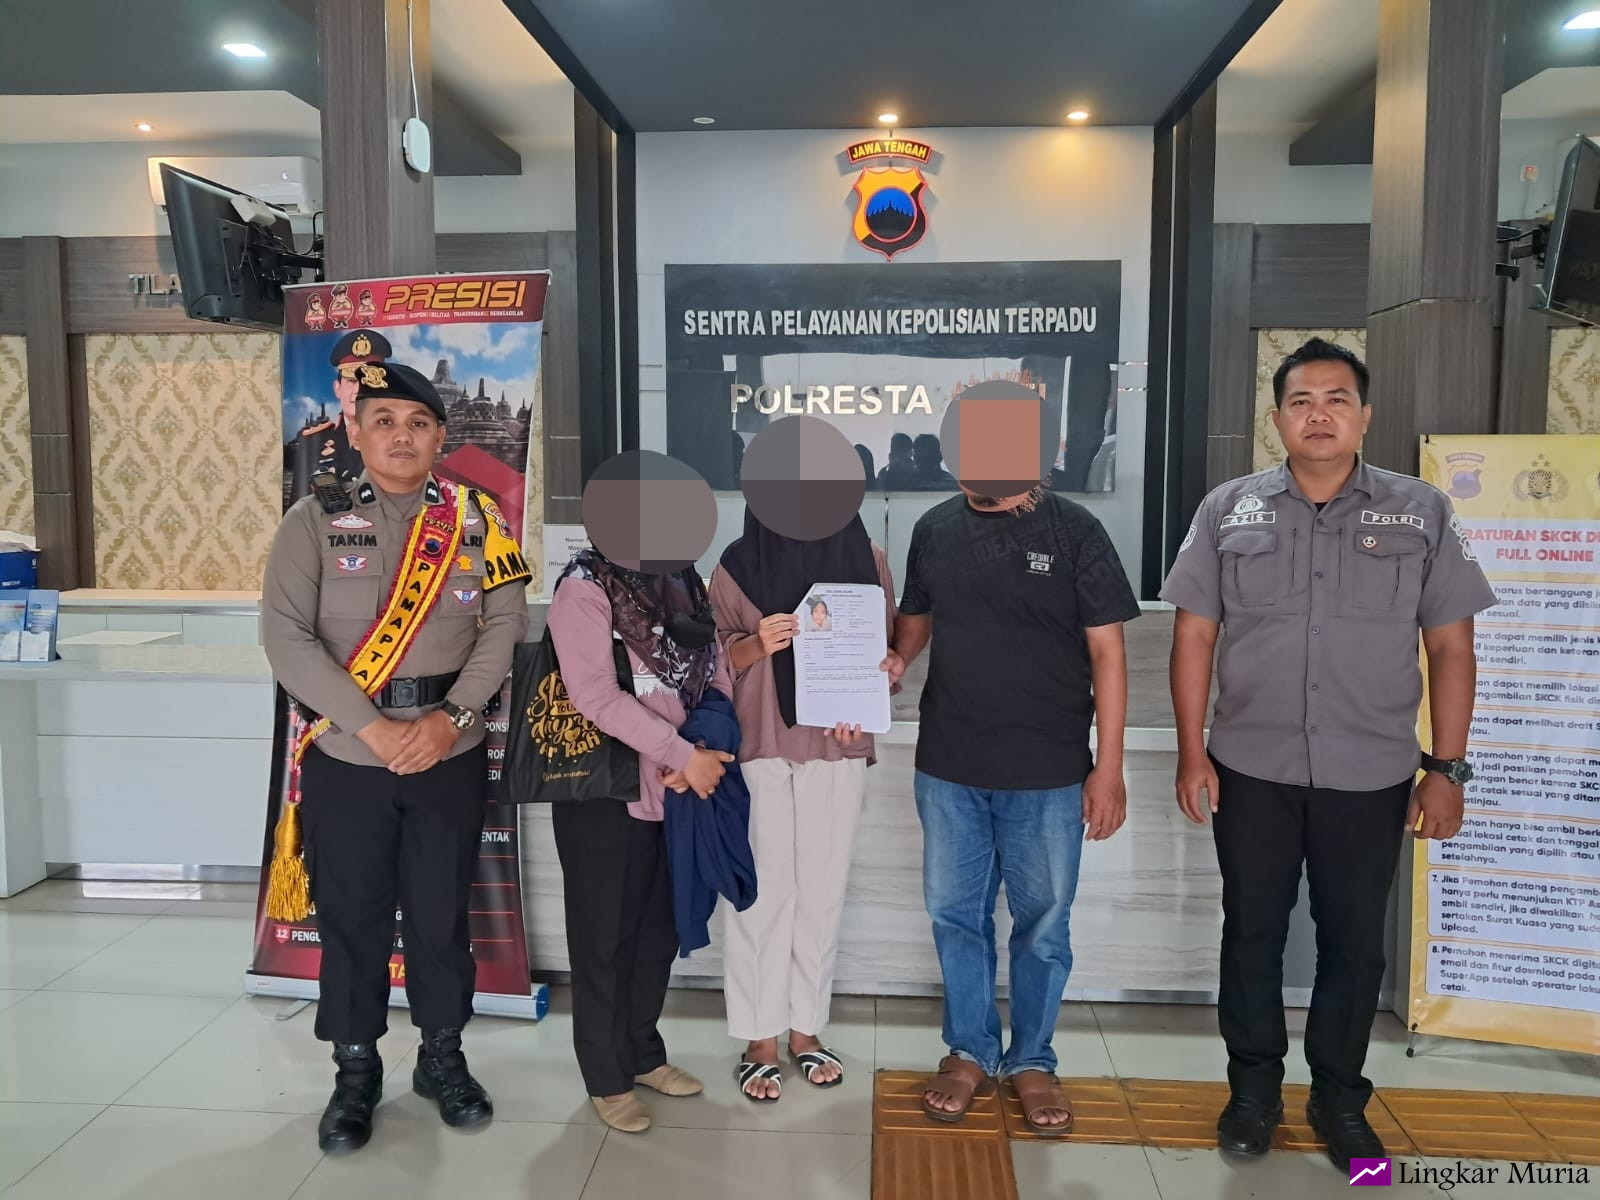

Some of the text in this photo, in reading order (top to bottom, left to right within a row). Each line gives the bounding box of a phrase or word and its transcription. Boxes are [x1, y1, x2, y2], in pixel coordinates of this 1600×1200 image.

[853, 141, 927, 159] JAWA TENGAH
[383, 280, 527, 313] PRESISI
[684, 307, 1097, 336] SENTRA PELAYANAN KEPOLISIAN TERPADU
[730, 383, 933, 415] POLRESTA
[1230, 514, 1264, 524] AZIS
[1371, 514, 1414, 524] POLRI
[328, 534, 377, 548] TAKIM
[1540, 530, 1582, 542] SKCK
[1496, 548, 1594, 562] FULL ONLINE
[1494, 586, 1523, 594] harus
[1525, 587, 1593, 598] bertanggung
[1517, 599, 1541, 607] data
[1544, 601, 1570, 609] yang
[355, 562, 431, 682] PAMAPTA
[1494, 632, 1525, 642] dapat
[1528, 634, 1567, 643] memilih
[1570, 635, 1595, 644] jenis
[1483, 643, 1535, 653] keperluan
[1537, 646, 1557, 654] dan
[1493, 680, 1523, 689] dapat
[1526, 682, 1566, 691] memilih
[1569, 684, 1599, 693] lokasi
[1534, 693, 1562, 702] SKCK
[1492, 716, 1523, 726] dapat
[1525, 718, 1564, 728] melihat
[1477, 751, 1523, 761] pemohon
[1526, 754, 1551, 763] yang
[1554, 756, 1585, 765] dapat
[1481, 762, 1500, 771] jadi
[1549, 767, 1597, 777] pemohon
[1540, 778, 1577, 788] karena
[1480, 786, 1508, 795] cetak
[1545, 791, 1570, 801] yang
[1489, 820, 1520, 830] hanya
[1523, 822, 1544, 832] bisa
[1547, 824, 1575, 834] ambil
[1474, 830, 1503, 840] lokasi
[1505, 833, 1533, 843] cetak
[1536, 835, 1555, 844] dan
[1558, 837, 1599, 849] tanggal
[1441, 840, 1506, 853] pengambilan
[1509, 846, 1534, 857] yang
[1537, 847, 1568, 858] dipilih
[1570, 851, 1594, 860] atau
[1432, 875, 1600, 896] 7. Jika Pemohon datang pengamb
[1441, 887, 1471, 897] hanya
[1473, 890, 1499, 900] perlu
[1502, 893, 1563, 905] menunjukan
[1566, 897, 1585, 906] KTP
[1441, 899, 1468, 908] ambil
[1509, 904, 1527, 915] jika
[1529, 905, 1584, 919] diwakilkan
[1441, 911, 1483, 922] sertakan
[1486, 915, 1513, 924] Surat
[1516, 918, 1547, 928] Kuasa
[1549, 921, 1575, 932] yang
[1441, 922, 1479, 934] Upload.
[276, 929, 288, 939] 12
[1432, 945, 1440, 954] 8.
[1442, 946, 1487, 958] Pemohon
[1489, 951, 1540, 963] menerima
[1542, 955, 1569, 966] SKCK
[1440, 957, 1467, 968] email
[1470, 960, 1489, 970] dan
[1491, 962, 1513, 972] fitur
[1515, 965, 1565, 977] download
[1568, 970, 1595, 981] pada
[1492, 975, 1529, 987] setelah
[1531, 979, 1576, 991] operator
